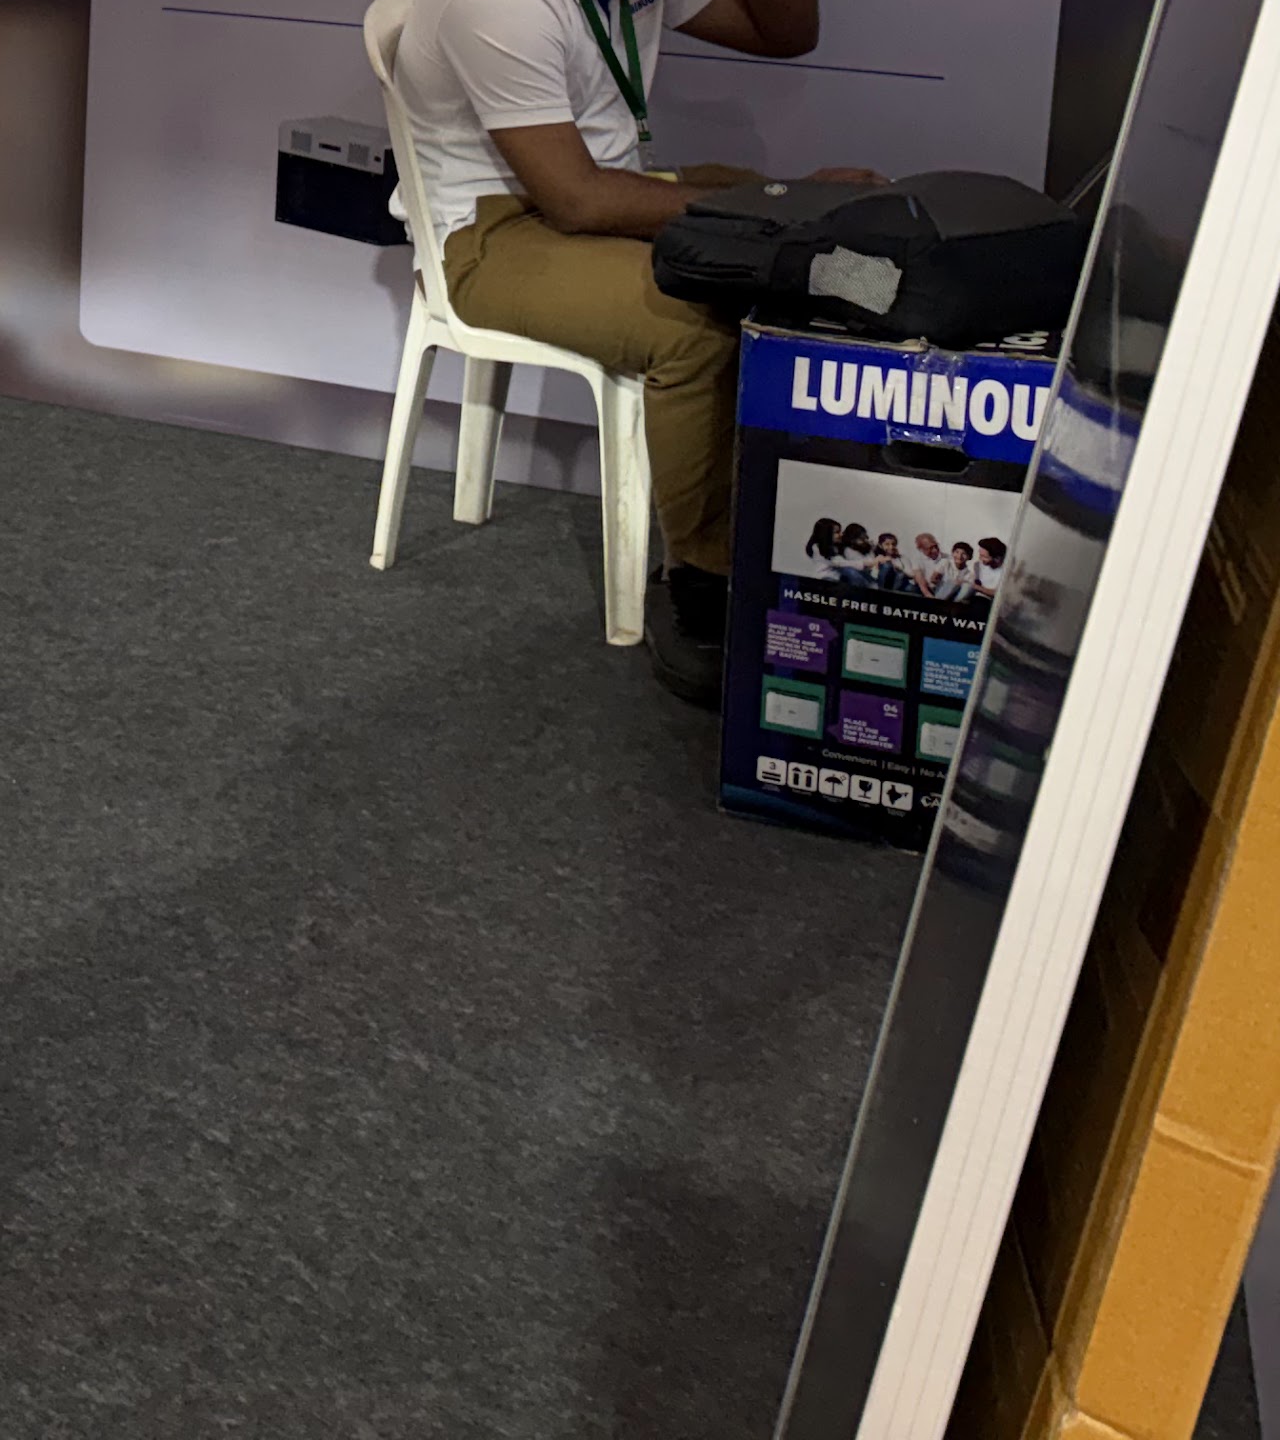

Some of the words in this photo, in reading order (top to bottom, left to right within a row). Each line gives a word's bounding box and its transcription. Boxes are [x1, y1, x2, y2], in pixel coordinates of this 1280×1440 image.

[792, 356, 1051, 442] LUMINOU
[783, 588, 838, 607] HASSLE
[842, 598, 878, 614] FREE
[883, 605, 948, 625] BATTERY
[822, 748, 877, 768] Convenient
